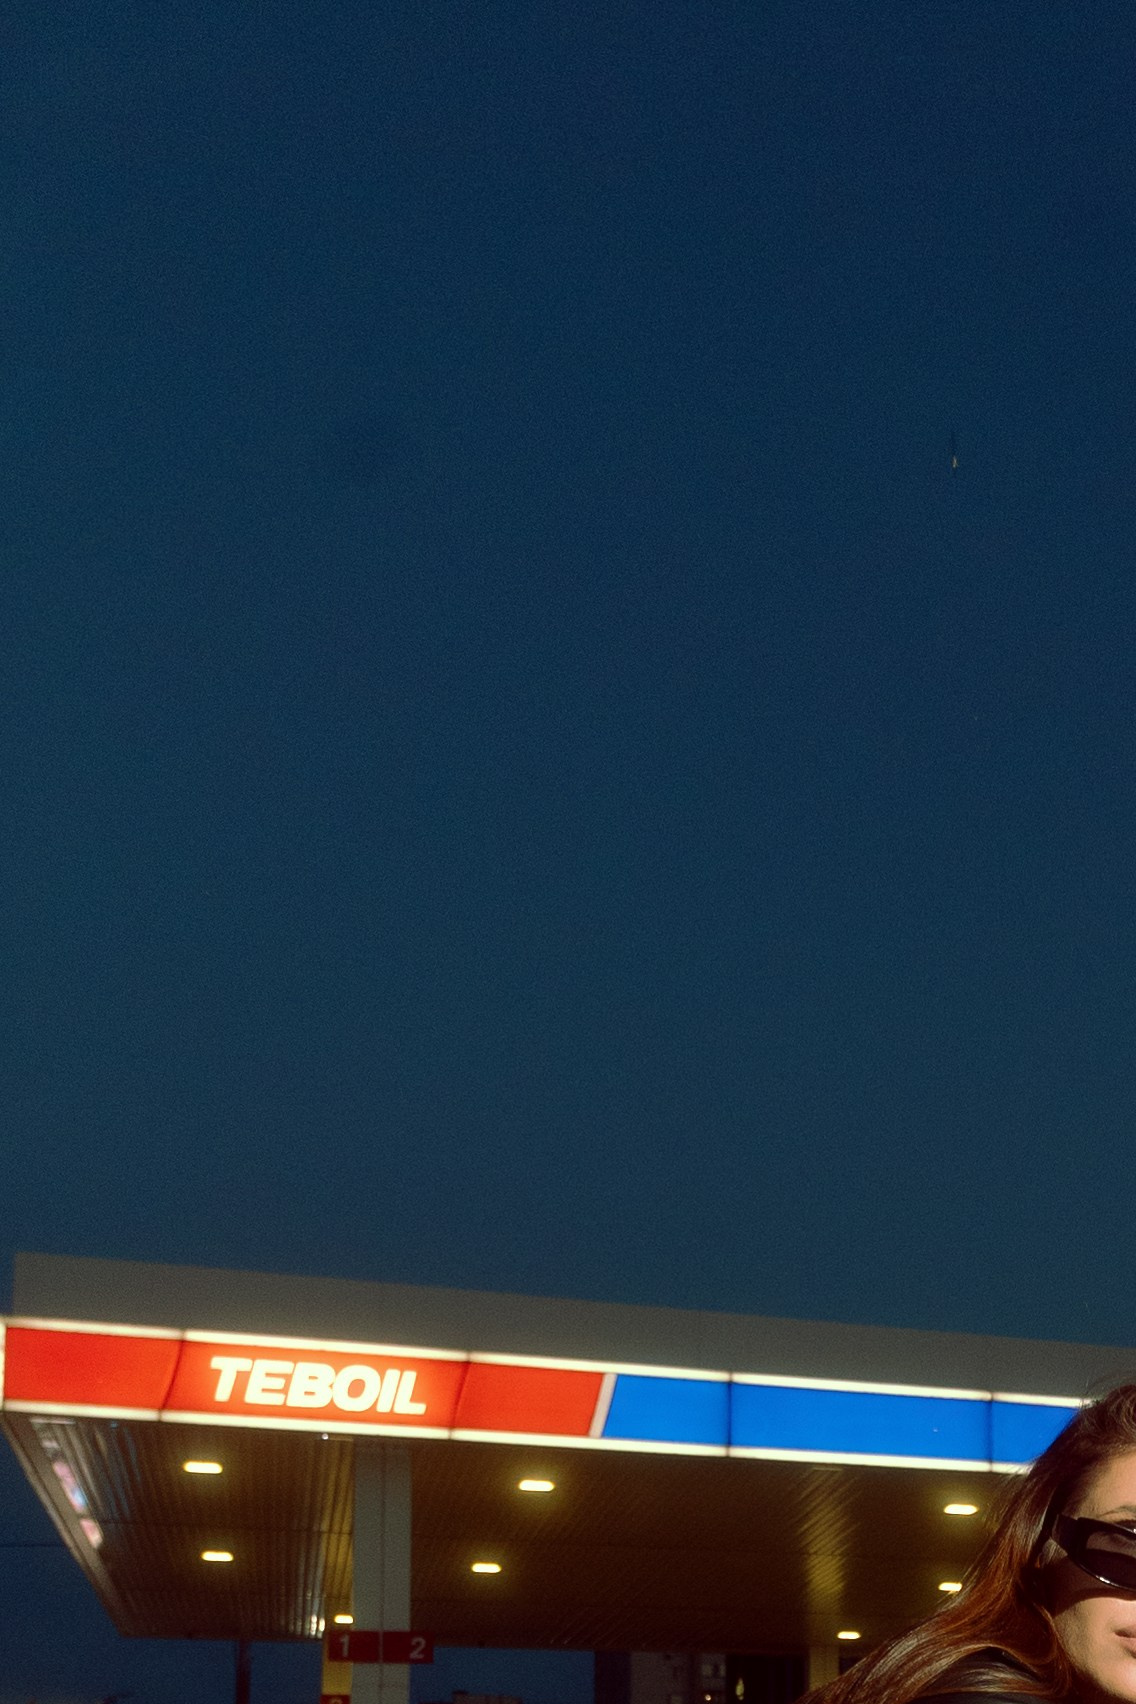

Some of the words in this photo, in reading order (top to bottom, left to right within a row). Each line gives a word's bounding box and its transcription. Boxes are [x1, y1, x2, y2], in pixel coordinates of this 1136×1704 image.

[210, 1355, 427, 1415] TEBOIL
[341, 1634, 350, 1658] 1
[409, 1637, 426, 1660] 2
